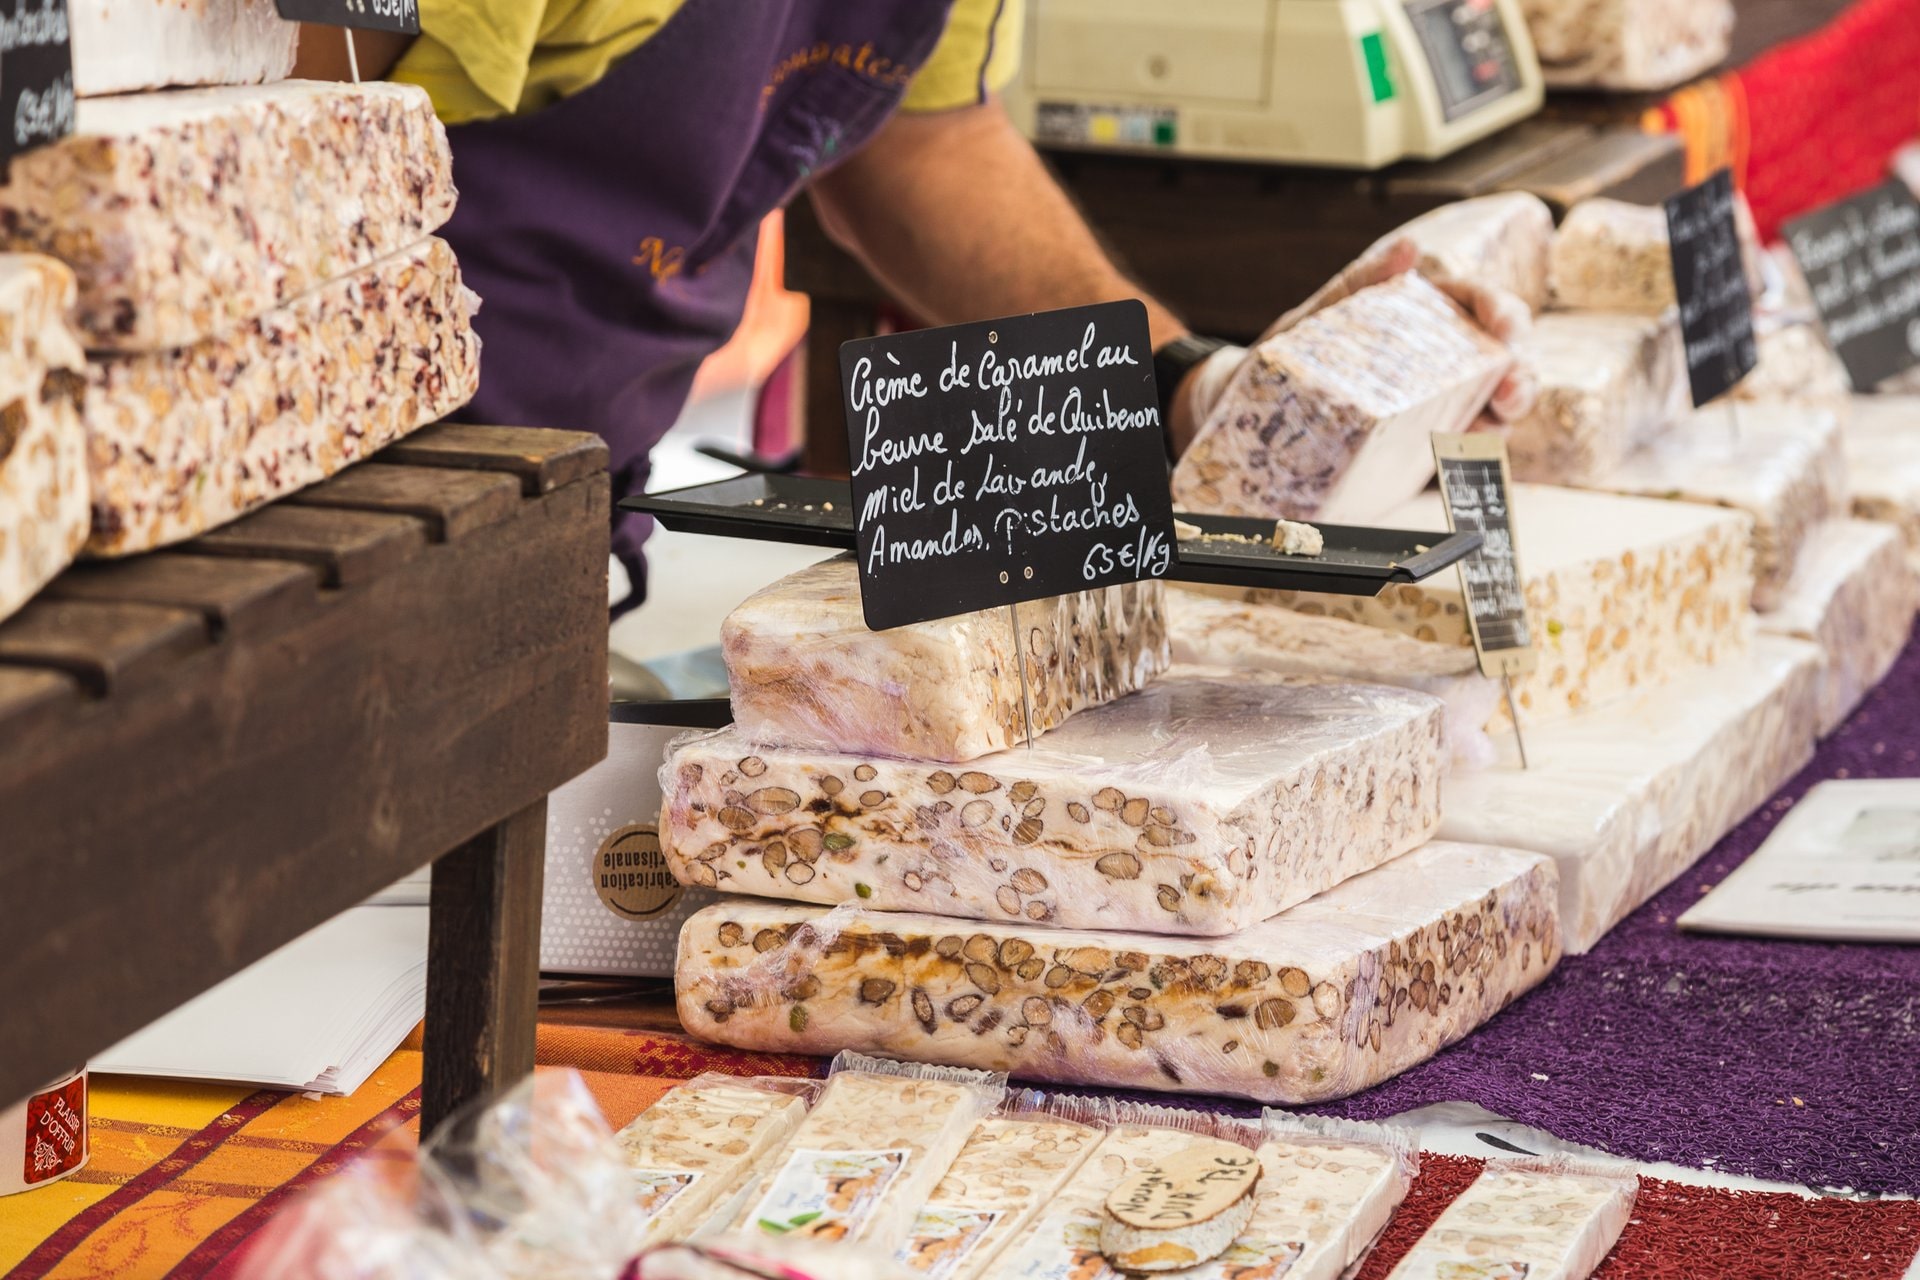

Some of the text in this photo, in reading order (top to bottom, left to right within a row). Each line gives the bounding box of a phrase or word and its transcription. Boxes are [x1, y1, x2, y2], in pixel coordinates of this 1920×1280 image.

[851, 321, 1138, 412] Crème de Caramel au
[960, 384, 1023, 455] salé
[1028, 385, 1056, 435] de
[1060, 386, 1160, 435] Quiberon
[933, 460, 965, 505] de
[994, 481, 1141, 555] Pistaches
[603, 851, 665, 870] rtisanale
[39, 1110, 76, 1156] D'OFFRIR
[54, 1096, 80, 1135] PLAISIR
[1151, 1191, 1207, 1221] DUR
